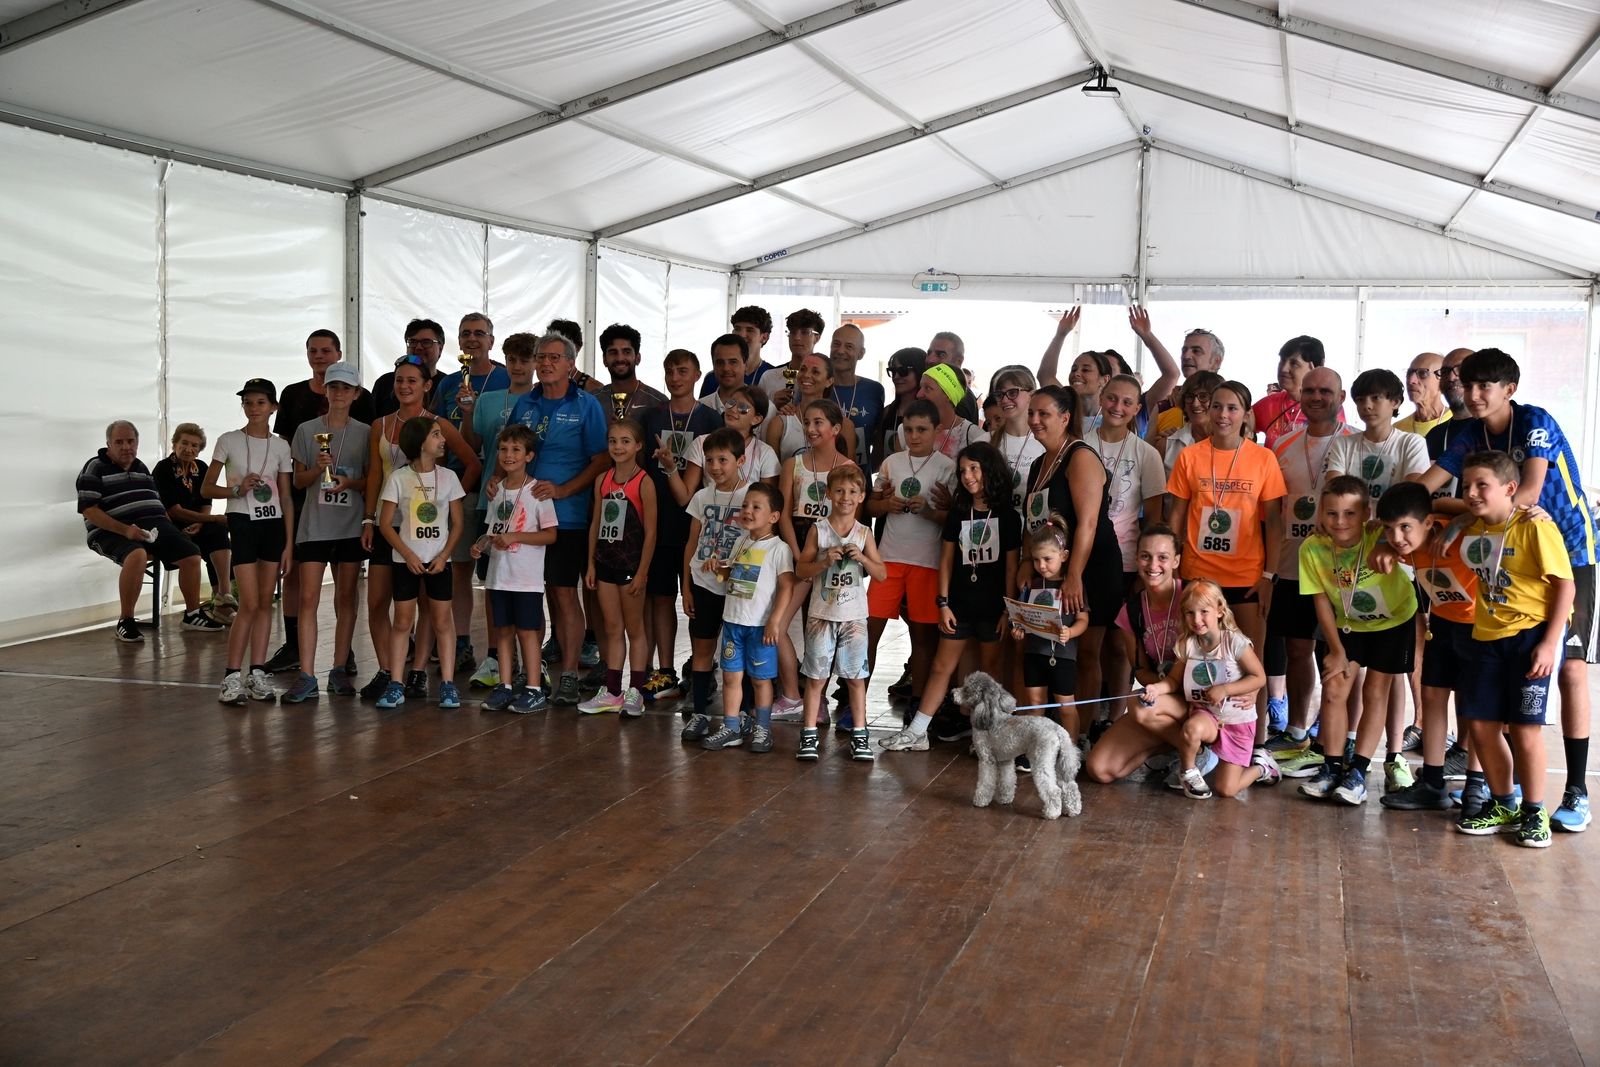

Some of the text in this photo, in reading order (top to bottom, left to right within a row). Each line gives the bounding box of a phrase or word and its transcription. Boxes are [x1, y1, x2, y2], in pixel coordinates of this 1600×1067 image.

[763, 249, 787, 261] COPRO
[1214, 480, 1253, 491] RESPECT
[324, 491, 348, 504] 612
[254, 505, 276, 518] 580
[804, 503, 829, 517] 620
[416, 526, 440, 539] 605
[601, 525, 619, 538] 616
[1203, 536, 1231, 552] 585
[968, 547, 993, 562] 611
[831, 572, 853, 587] 595
